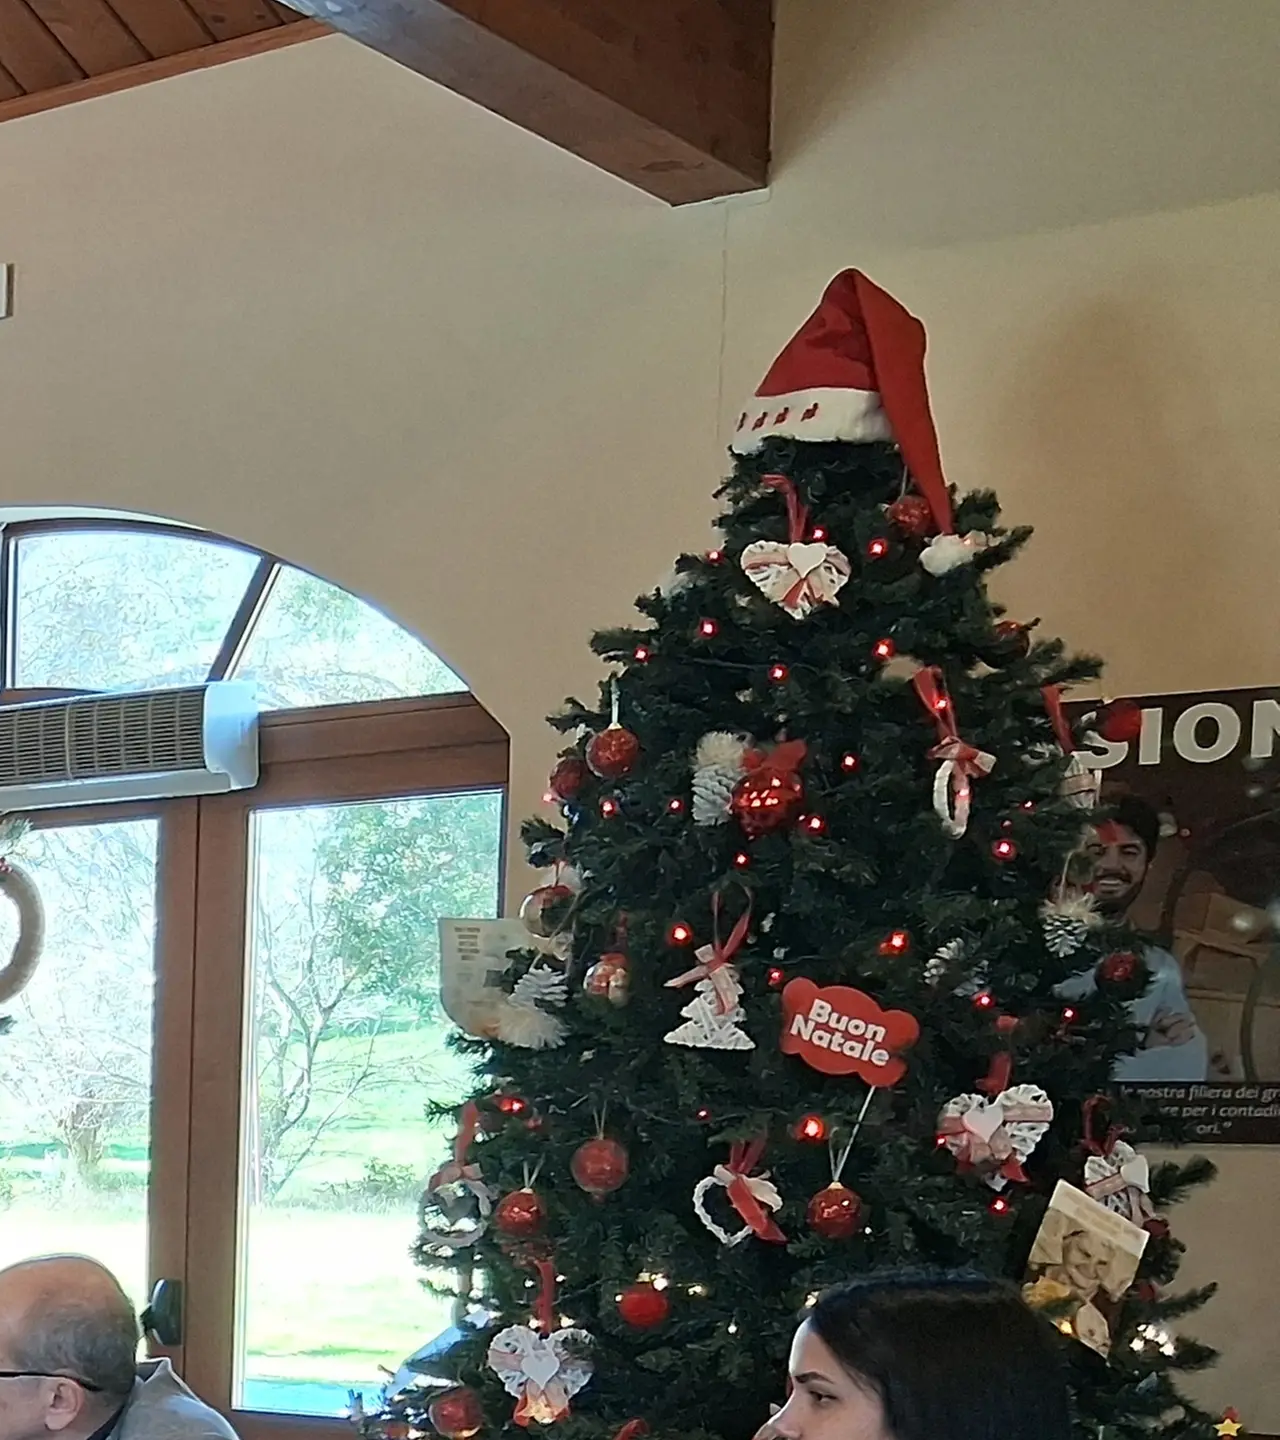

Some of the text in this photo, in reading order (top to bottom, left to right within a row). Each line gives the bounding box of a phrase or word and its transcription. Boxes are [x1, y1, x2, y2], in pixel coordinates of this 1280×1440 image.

[808, 998, 886, 1043] Buon
[790, 1014, 891, 1066] Natale
[1188, 1085, 1232, 1101] filiera
[1235, 1085, 1260, 1099] dei
[1261, 1088, 1280, 1104] gr
[1182, 1106, 1209, 1118] per
